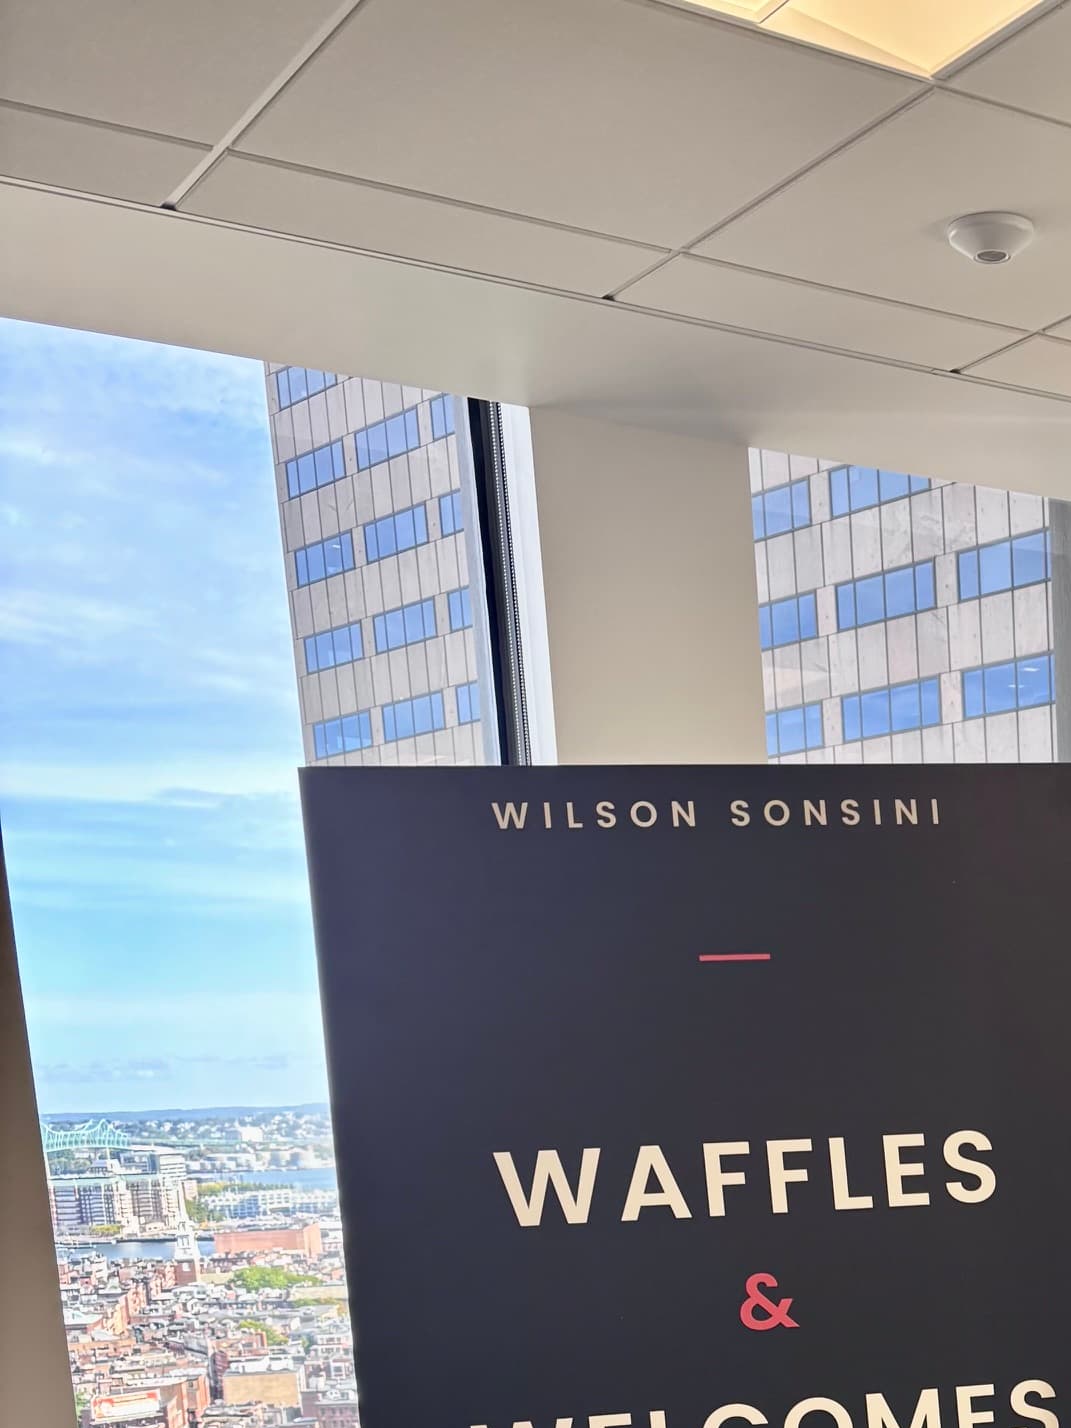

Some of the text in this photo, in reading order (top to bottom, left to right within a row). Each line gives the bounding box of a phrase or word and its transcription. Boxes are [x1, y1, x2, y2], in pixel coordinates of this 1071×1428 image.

[491, 798, 939, 830] WILSON SONSINI
[492, 1129, 998, 1227] WAFFLES
[739, 1272, 800, 1331] &
